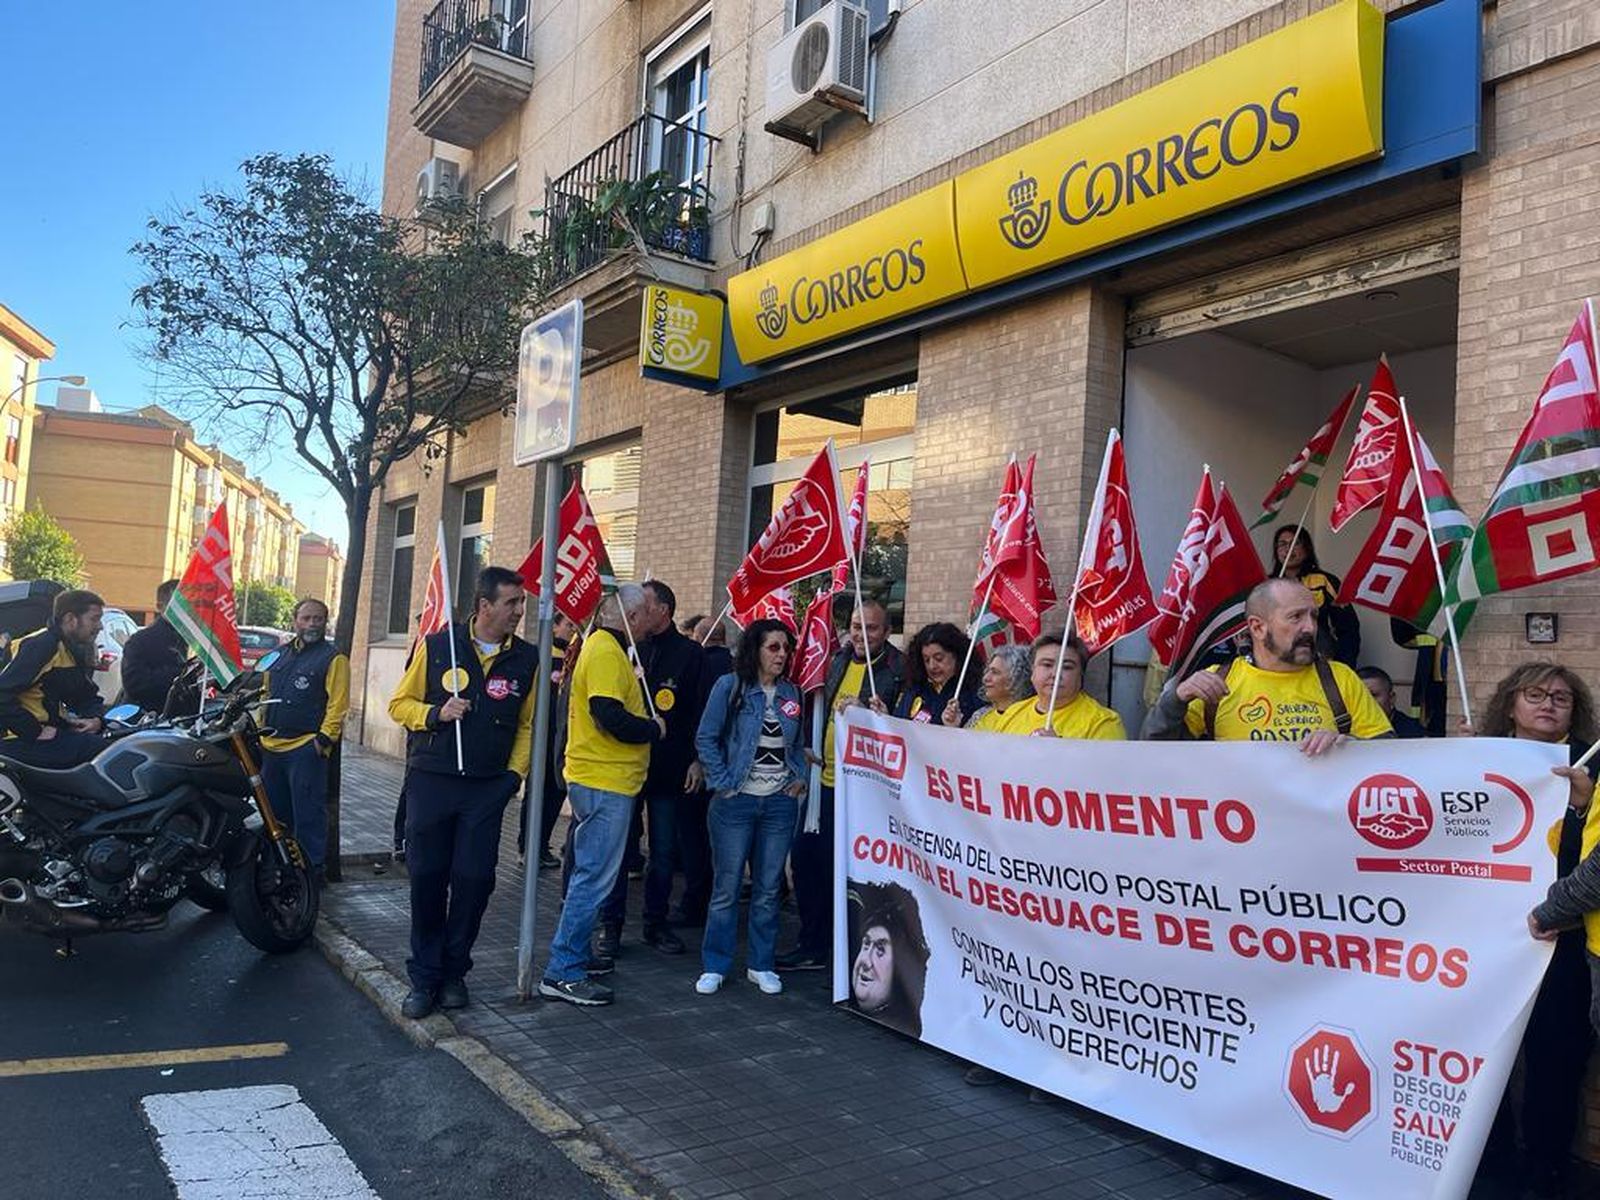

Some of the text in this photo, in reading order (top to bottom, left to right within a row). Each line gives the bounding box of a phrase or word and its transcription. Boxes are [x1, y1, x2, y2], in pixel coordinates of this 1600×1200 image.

[1058, 86, 1300, 226] CORREOS
[790, 240, 926, 324] CORREOS
[648, 289, 669, 365] CORREOS
[925, 764, 954, 803] ES
[957, 774, 991, 816] EL
[1001, 782, 1256, 844] MOMENTO
[1357, 786, 1419, 818] UGT
[1444, 816, 1491, 827] Servicios
[966, 844, 996, 876] DEL
[1000, 856, 1108, 896] SERVICIO
[1117, 874, 1231, 912] POSTAL
[1240, 883, 1407, 926] PÚBLICO
[1399, 859, 1492, 878] Sector Postal
[853, 835, 1469, 990] CONTRA EL DESGUACE DE CORREOS
[951, 927, 1255, 1034] CONTRA LOS RECORTES,
[961, 957, 1241, 1064] PLANTILLA SUFICIENTE
[983, 994, 1199, 1090] Y CON DERECHOS
[1392, 1130, 1410, 1149] EL
[1393, 1090, 1414, 1108] DE
